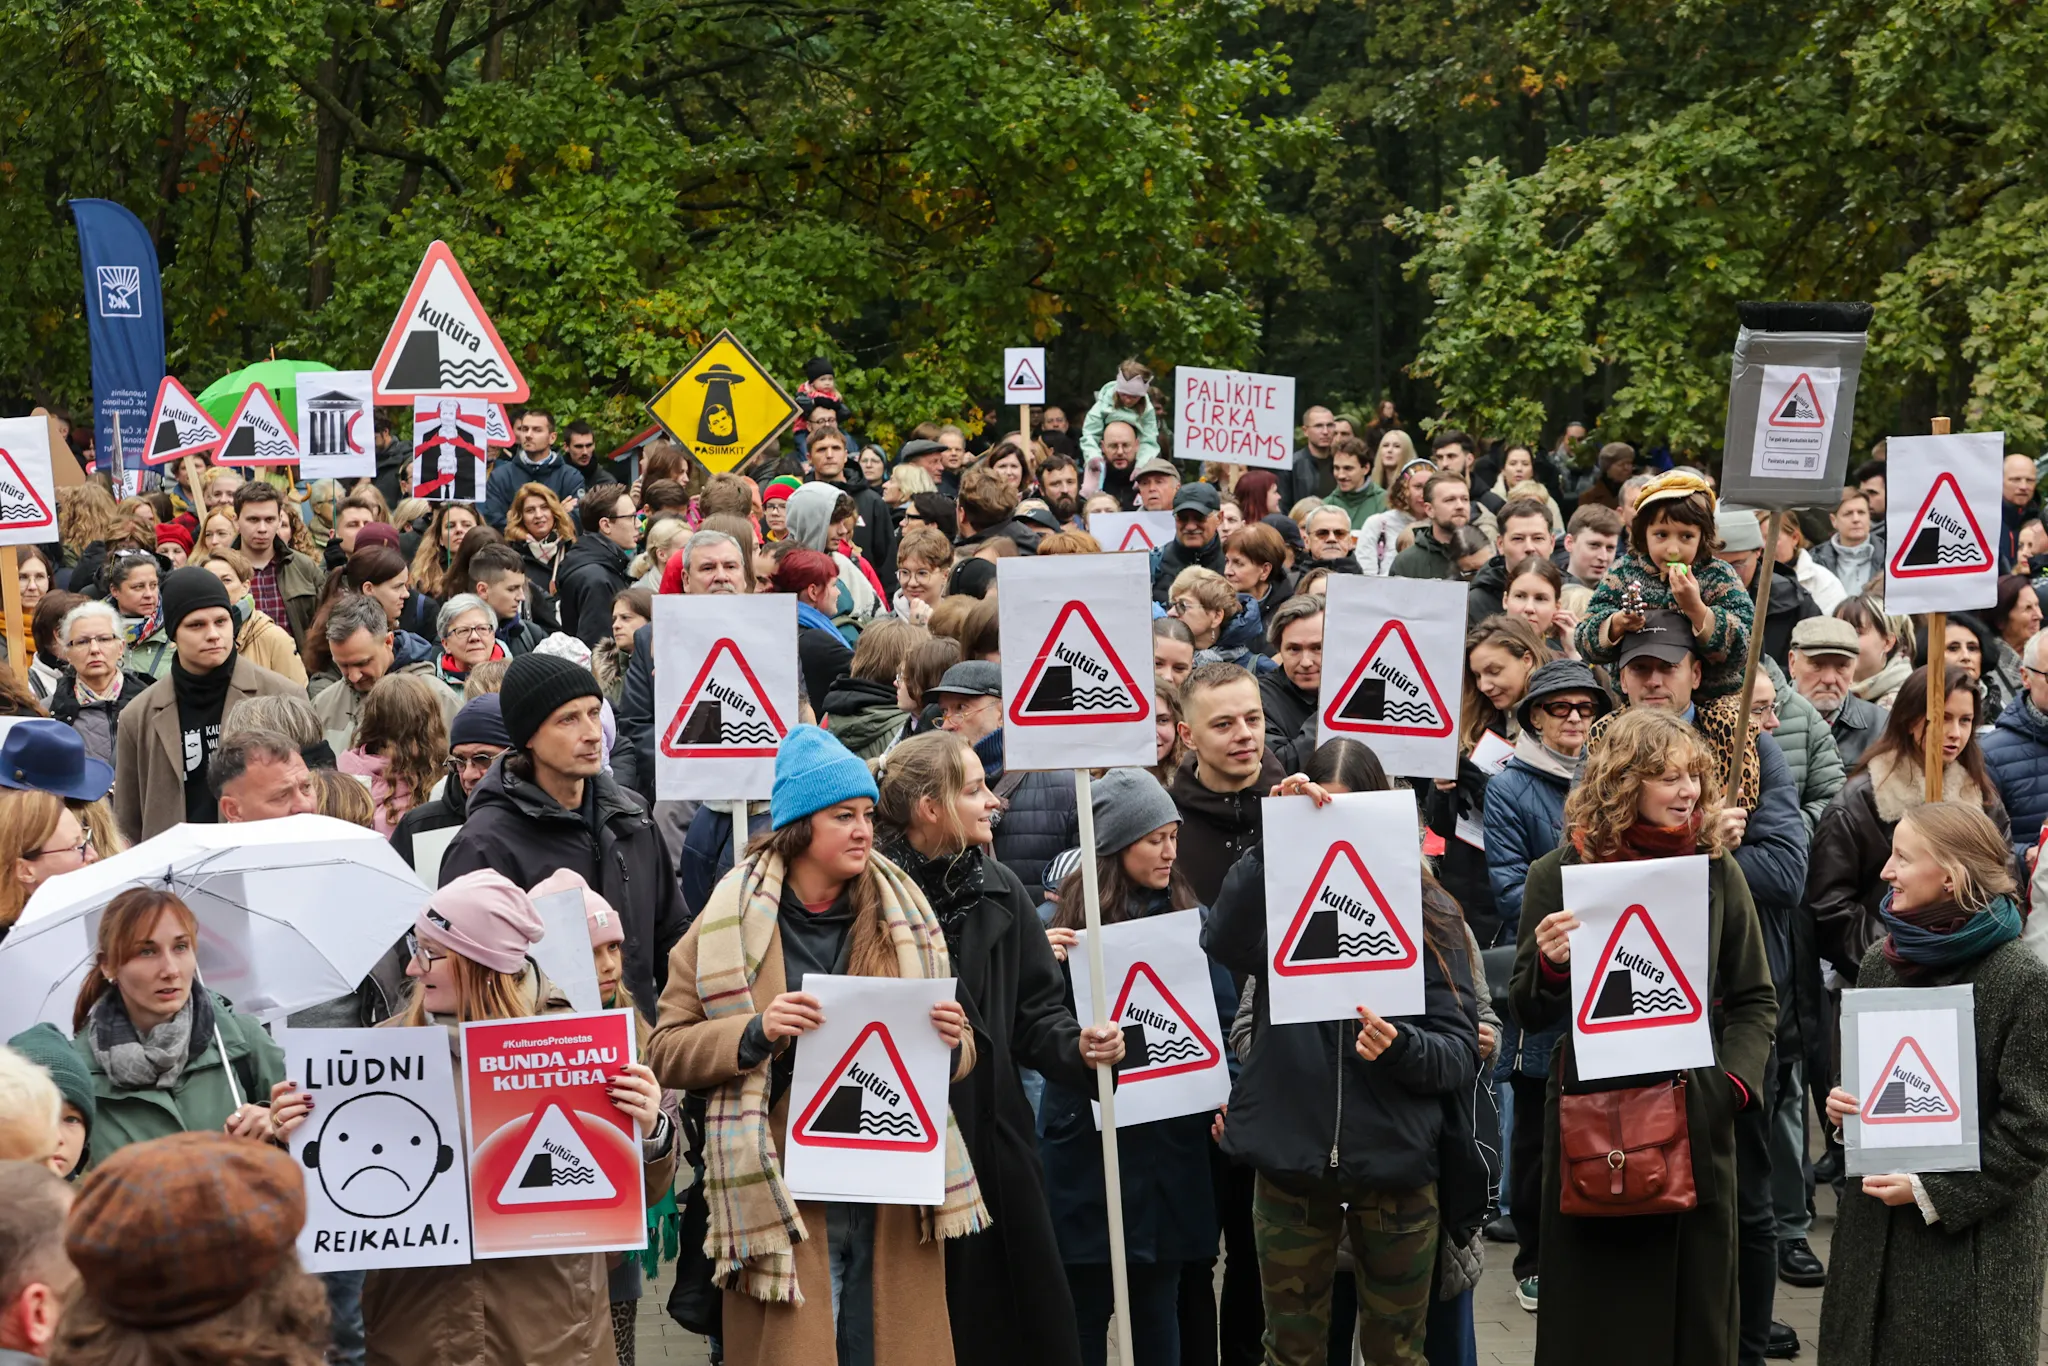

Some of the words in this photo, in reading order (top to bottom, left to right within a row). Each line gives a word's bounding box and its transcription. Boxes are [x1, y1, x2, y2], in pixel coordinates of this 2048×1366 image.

[418, 299, 481, 353] kultūra
[1187, 375, 1276, 410] PALIKITE
[162, 405, 198, 426] kultūra
[242, 410, 280, 438] kultūra
[1186, 425, 1286, 461] PROFAMS
[0, 481, 25, 502] ltūra
[1927, 507, 1967, 540] kultūra
[1054, 642, 1109, 683] kultūra
[1371, 657, 1420, 698] kultūra
[705, 677, 756, 717] kultūra
[1320, 885, 1376, 927] kultūra
[1614, 945, 1665, 984] kultūra
[1126, 1002, 1178, 1035] kultūra
[502, 1034, 593, 1050] #KulturosProtestas
[305, 1049, 424, 1090] LIŪDNI
[479, 1051, 566, 1073] BUNDA
[568, 1046, 618, 1065] JAU
[493, 1068, 608, 1092] KULTŪRA
[847, 1062, 901, 1107] kultūra
[1892, 1065, 1931, 1093] kultūra
[542, 1138, 580, 1166] kultūra
[314, 1223, 460, 1254] REIKALAI.
